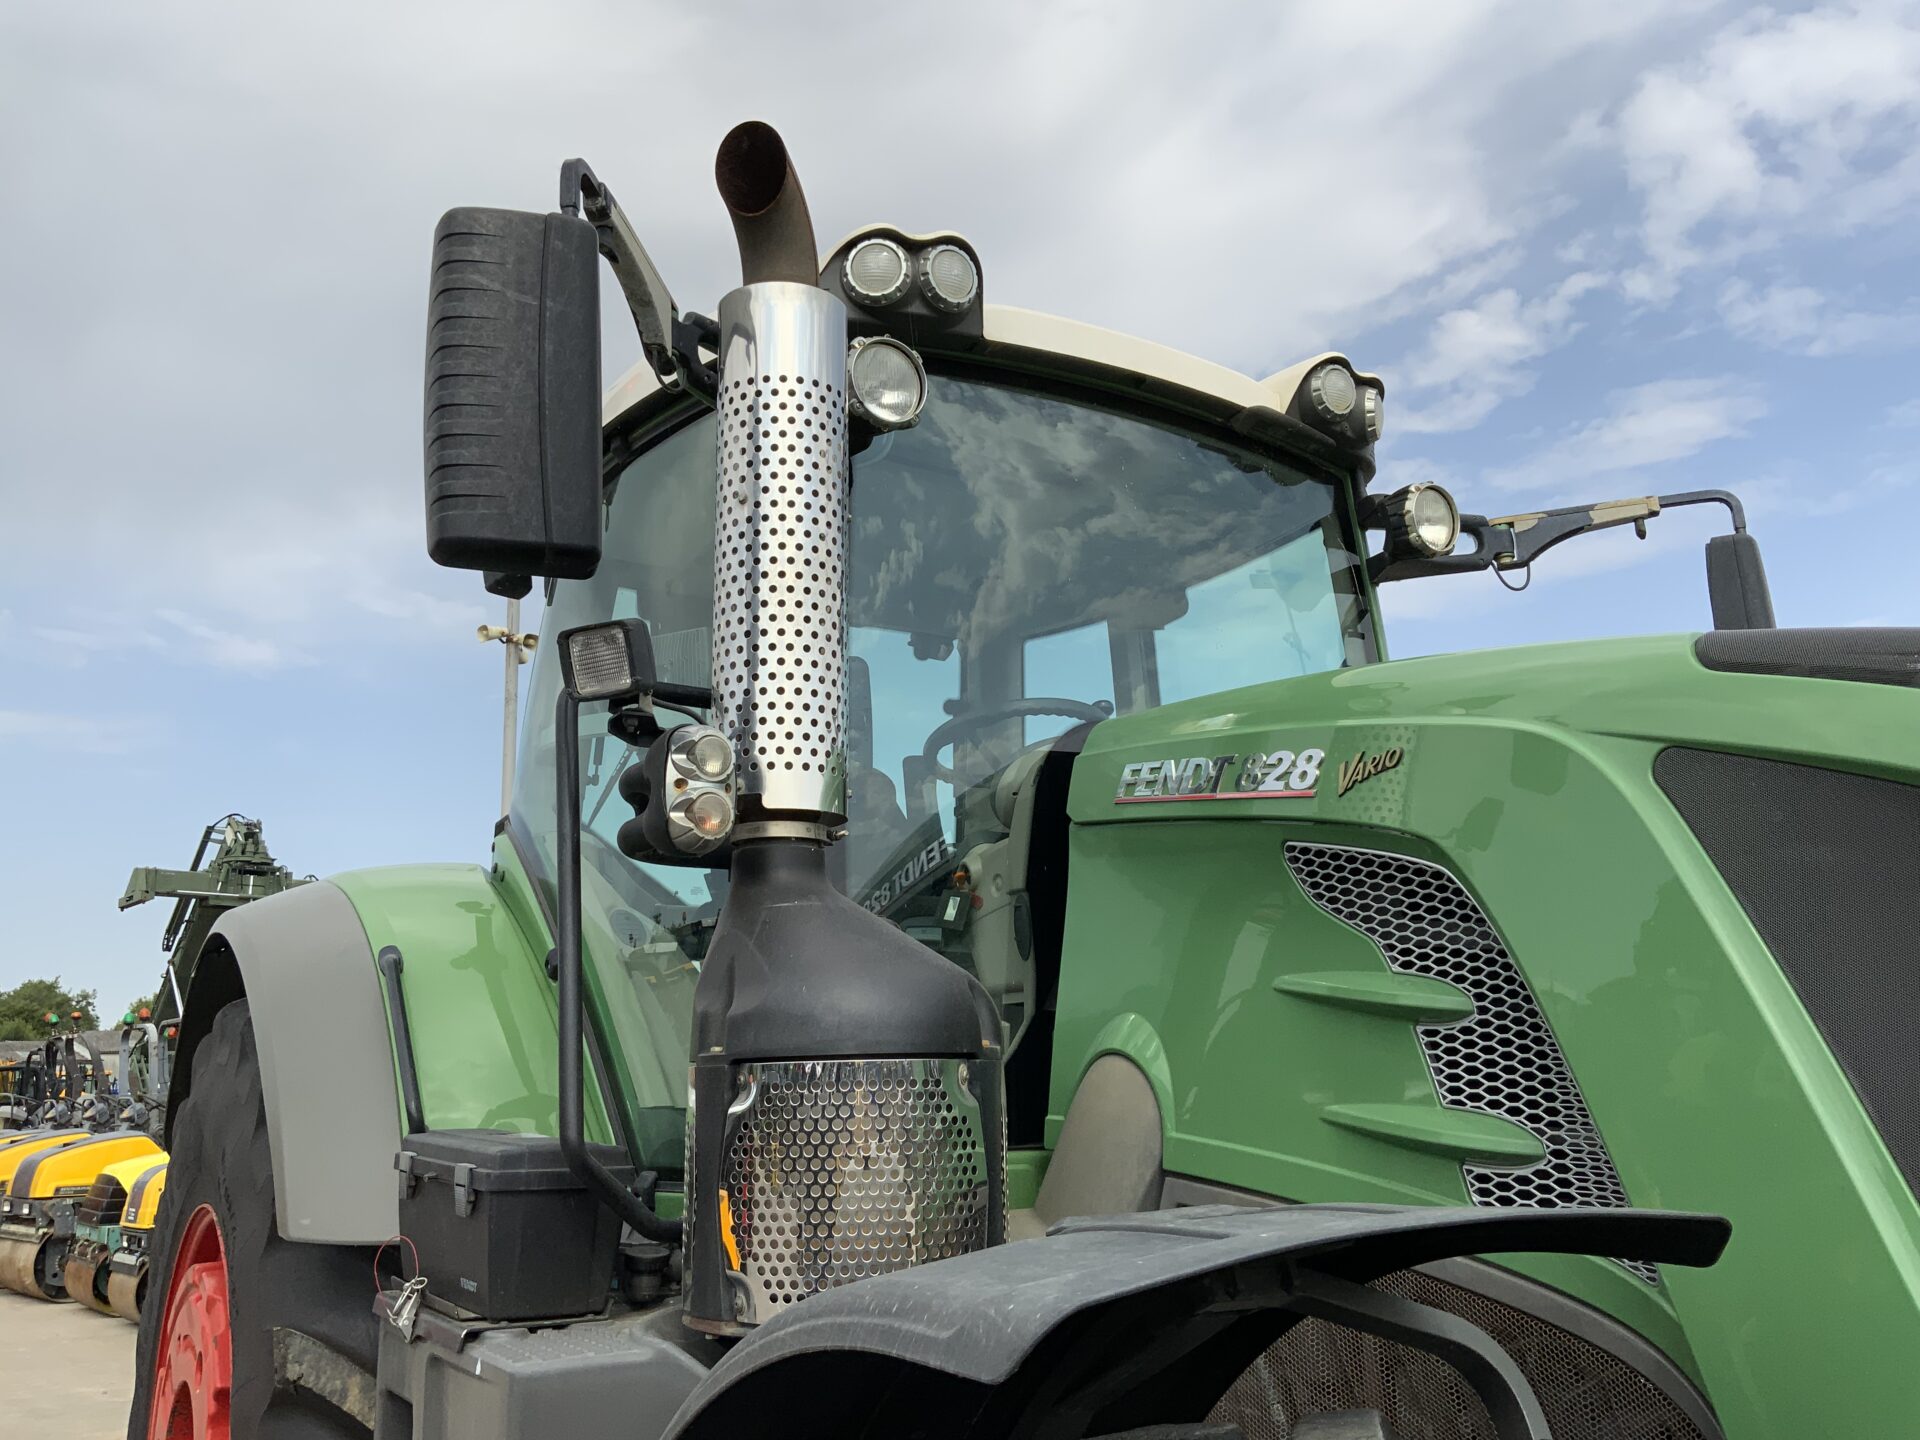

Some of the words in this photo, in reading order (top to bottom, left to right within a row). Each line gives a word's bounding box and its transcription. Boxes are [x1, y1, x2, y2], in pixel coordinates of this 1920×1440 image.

[1116, 754, 1238, 798] FENDT
[1235, 748, 1325, 792] 828
[1338, 747, 1404, 797] VARIO
